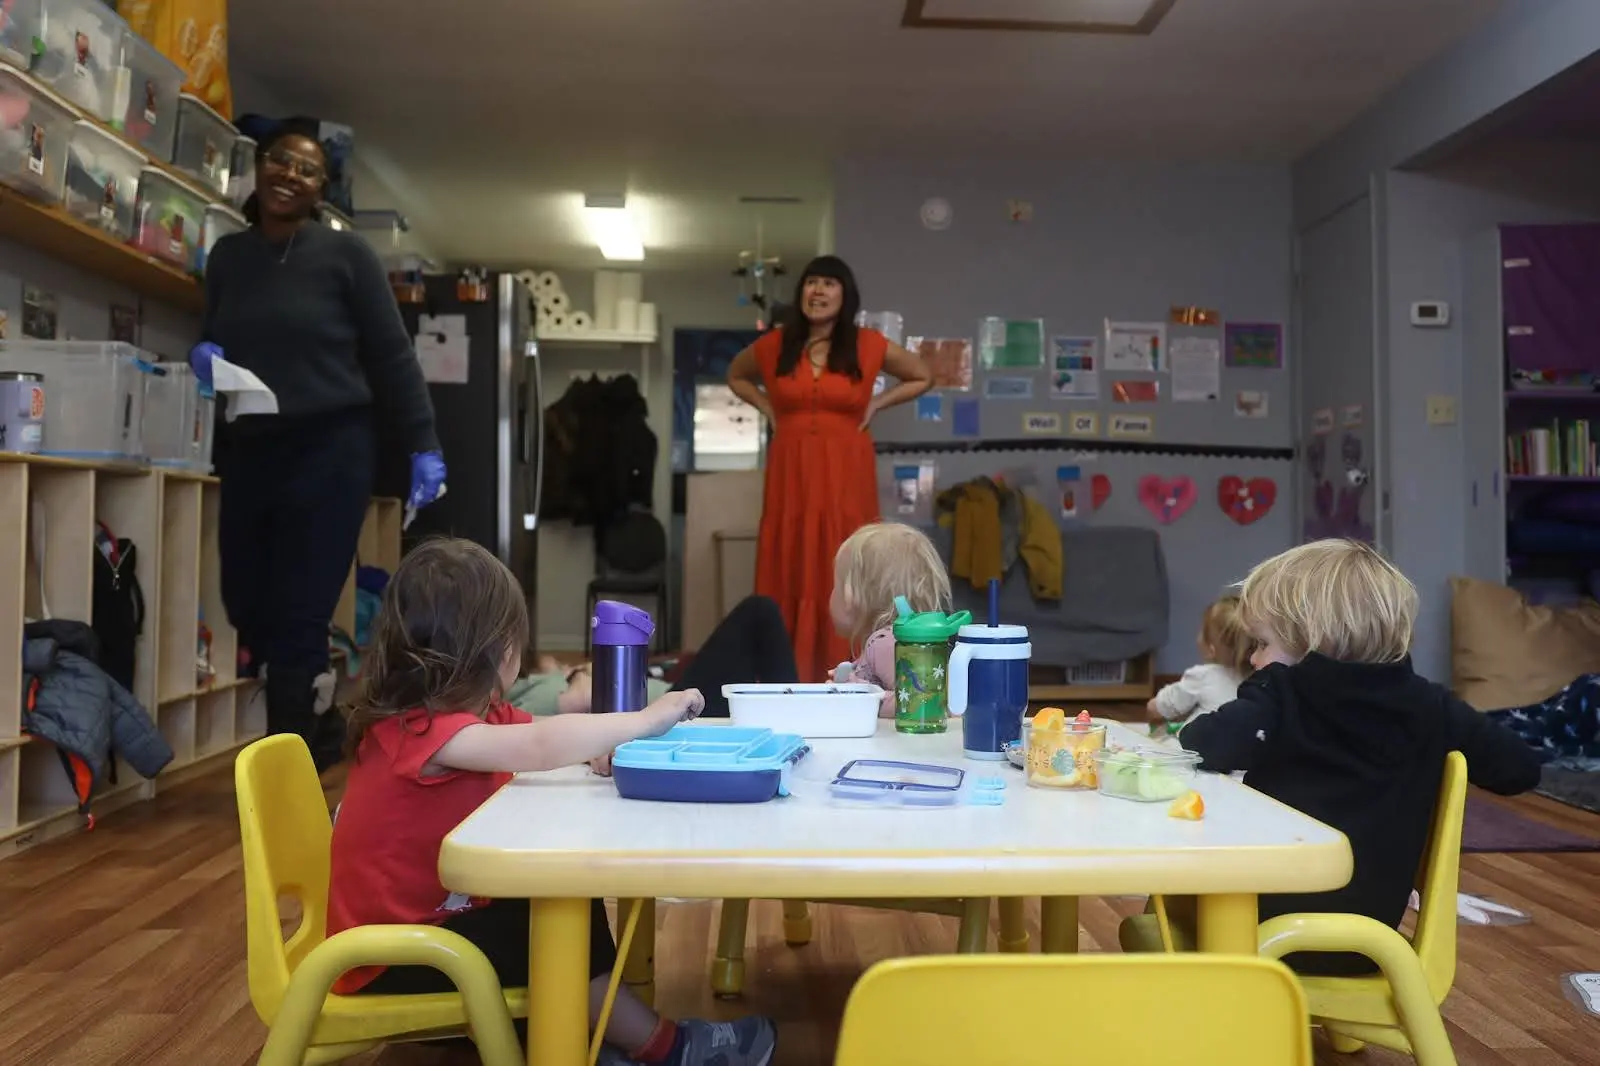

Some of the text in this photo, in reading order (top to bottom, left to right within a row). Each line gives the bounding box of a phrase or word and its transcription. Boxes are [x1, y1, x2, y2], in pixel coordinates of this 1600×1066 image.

[1029, 417, 1148, 431] Wall Of Fame
